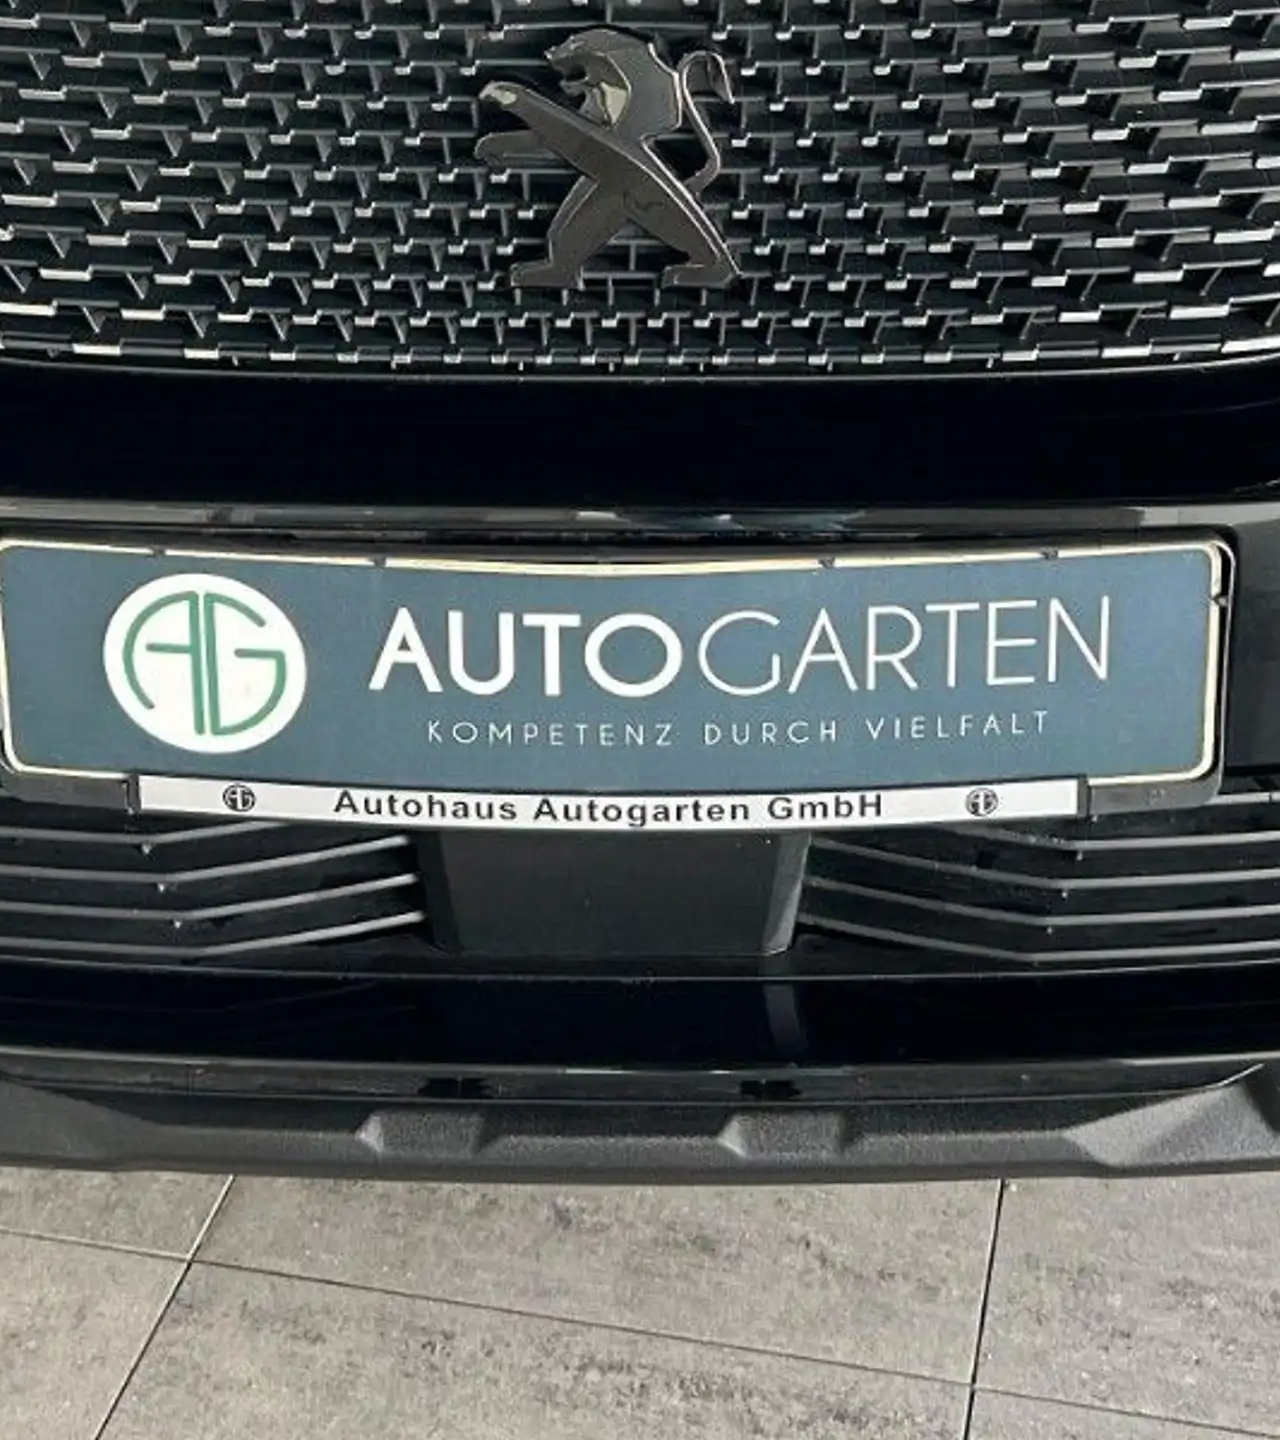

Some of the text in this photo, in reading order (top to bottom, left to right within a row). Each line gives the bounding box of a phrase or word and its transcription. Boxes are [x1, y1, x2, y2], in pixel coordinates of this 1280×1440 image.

[122, 589, 287, 736] AG
[368, 594, 1111, 698] AUTOGARTEN
[427, 710, 1049, 747] KOMPETENZ DURCH VIELFALT
[332, 789, 883, 828] Autohaus Autogarten GmbH
